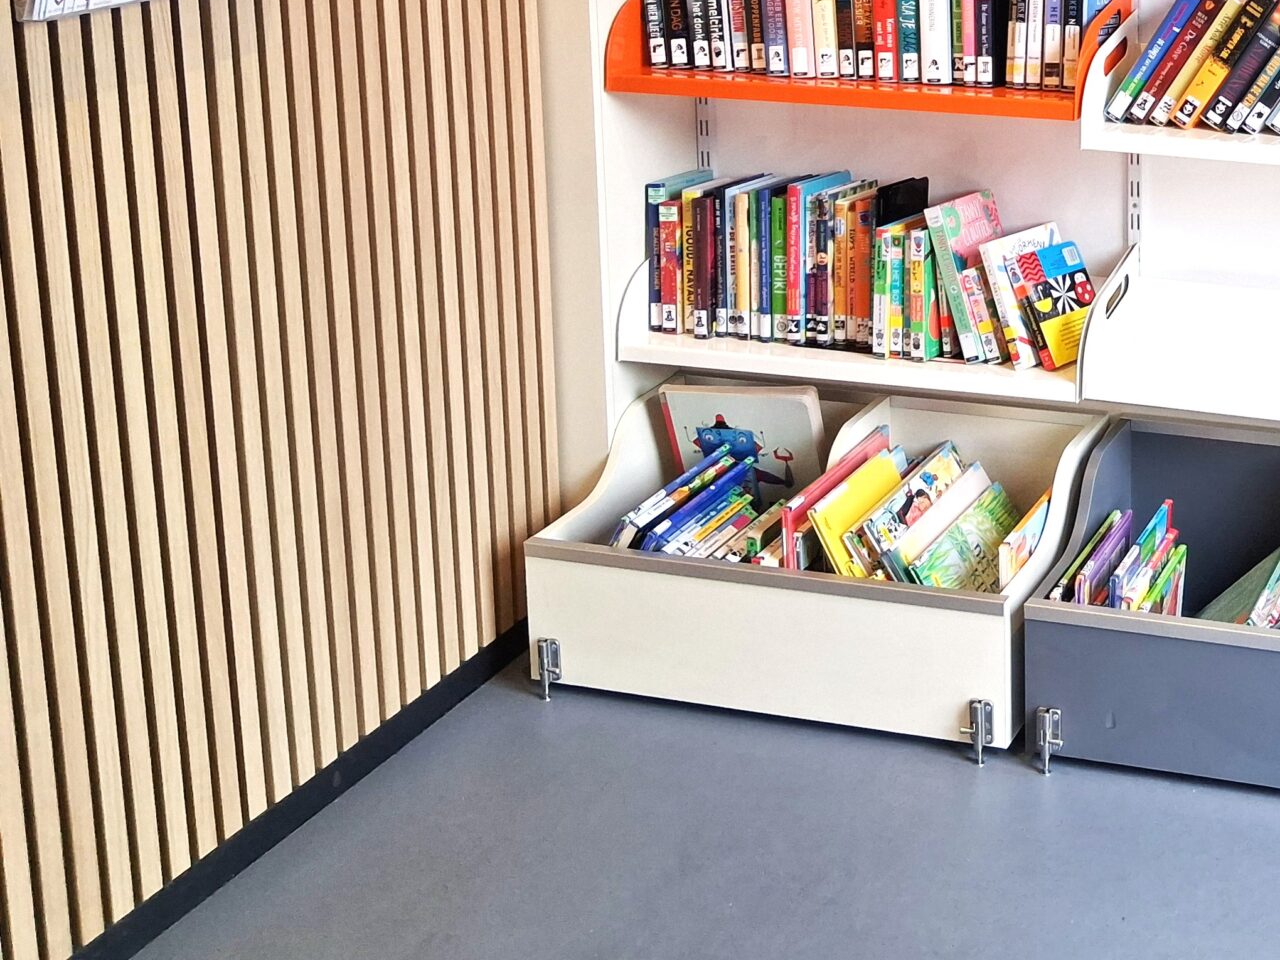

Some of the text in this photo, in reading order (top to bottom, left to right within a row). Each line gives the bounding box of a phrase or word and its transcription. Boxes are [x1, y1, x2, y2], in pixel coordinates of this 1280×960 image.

[647, 5, 659, 20] HIER
[692, 2, 701, 15] het
[1049, 6, 1058, 24] HET
[671, 9, 681, 30] DAG
[768, 18, 776, 38] VOOR
[775, 13, 783, 27] EEN
[900, 1, 917, 52] SLA JE SLAG
[686, 230, 694, 259] GOUD
